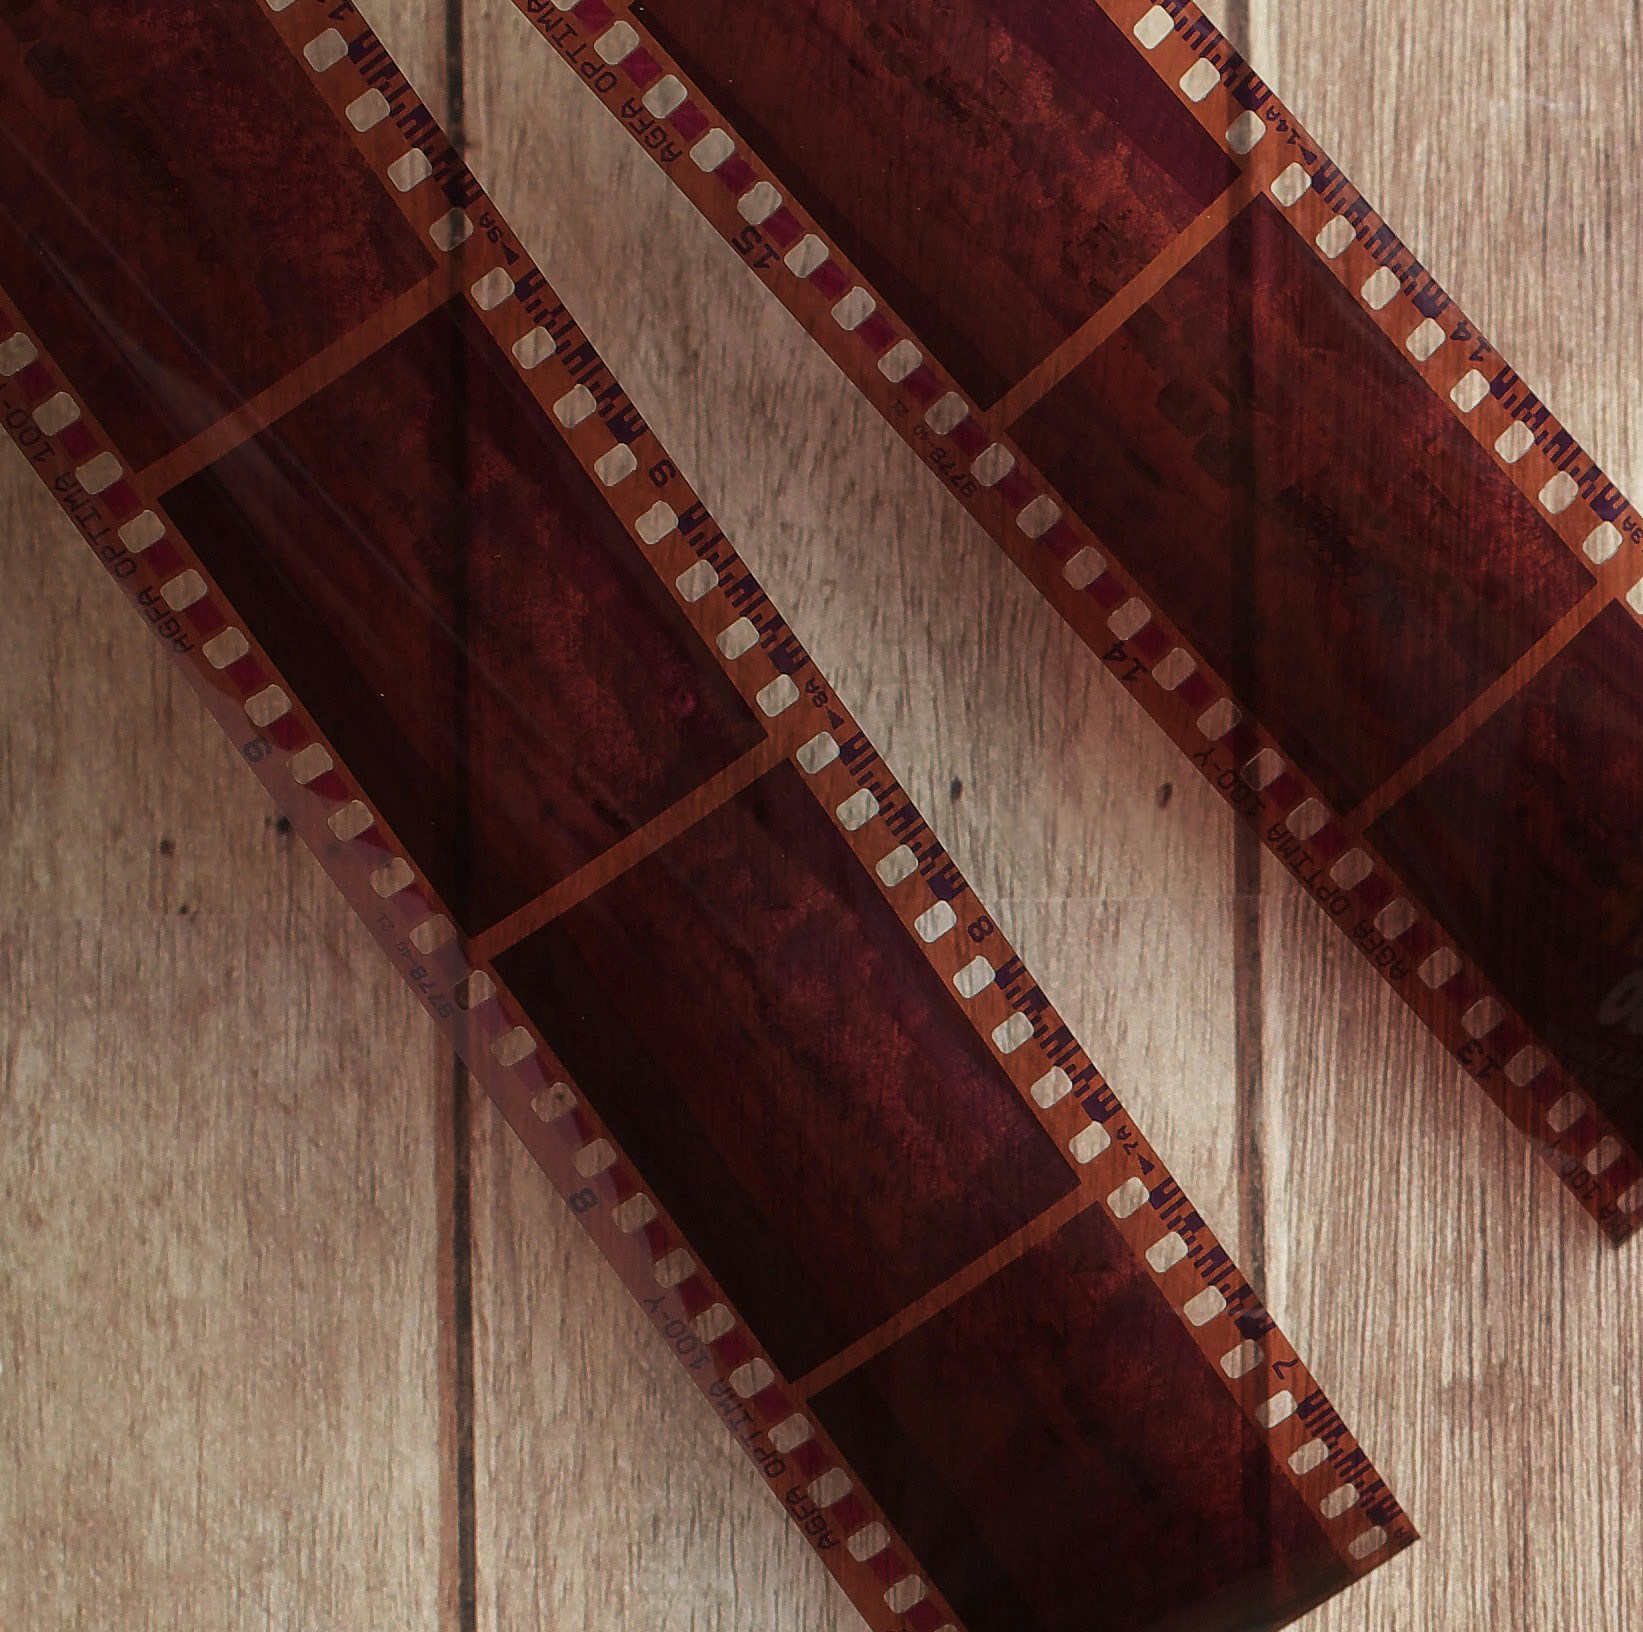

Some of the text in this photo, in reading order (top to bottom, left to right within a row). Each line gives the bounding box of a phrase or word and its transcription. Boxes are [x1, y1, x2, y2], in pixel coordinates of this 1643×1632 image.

[619, 97, 681, 164] AGFA
[1264, 106, 1298, 144] 14A
[476, 211, 505, 243] 9A
[733, 225, 778, 271] 15
[1447, 319, 1491, 364] 14
[646, 457, 677, 487] 9
[0, 383, 193, 657] AGFA OPTIMA 100-
[1102, 640, 1147, 686] 14
[241, 732, 274, 764] 9
[1193, 743, 1410, 983] AGFA OPTIMA 100-Y
[965, 914, 996, 944] 8
[1456, 1037, 1499, 1082] 13
[567, 1184, 599, 1215] 8
[1272, 1351, 1300, 1379] 7
[644, 1290, 839, 1553] AGFA OPTIMA 100-Y
